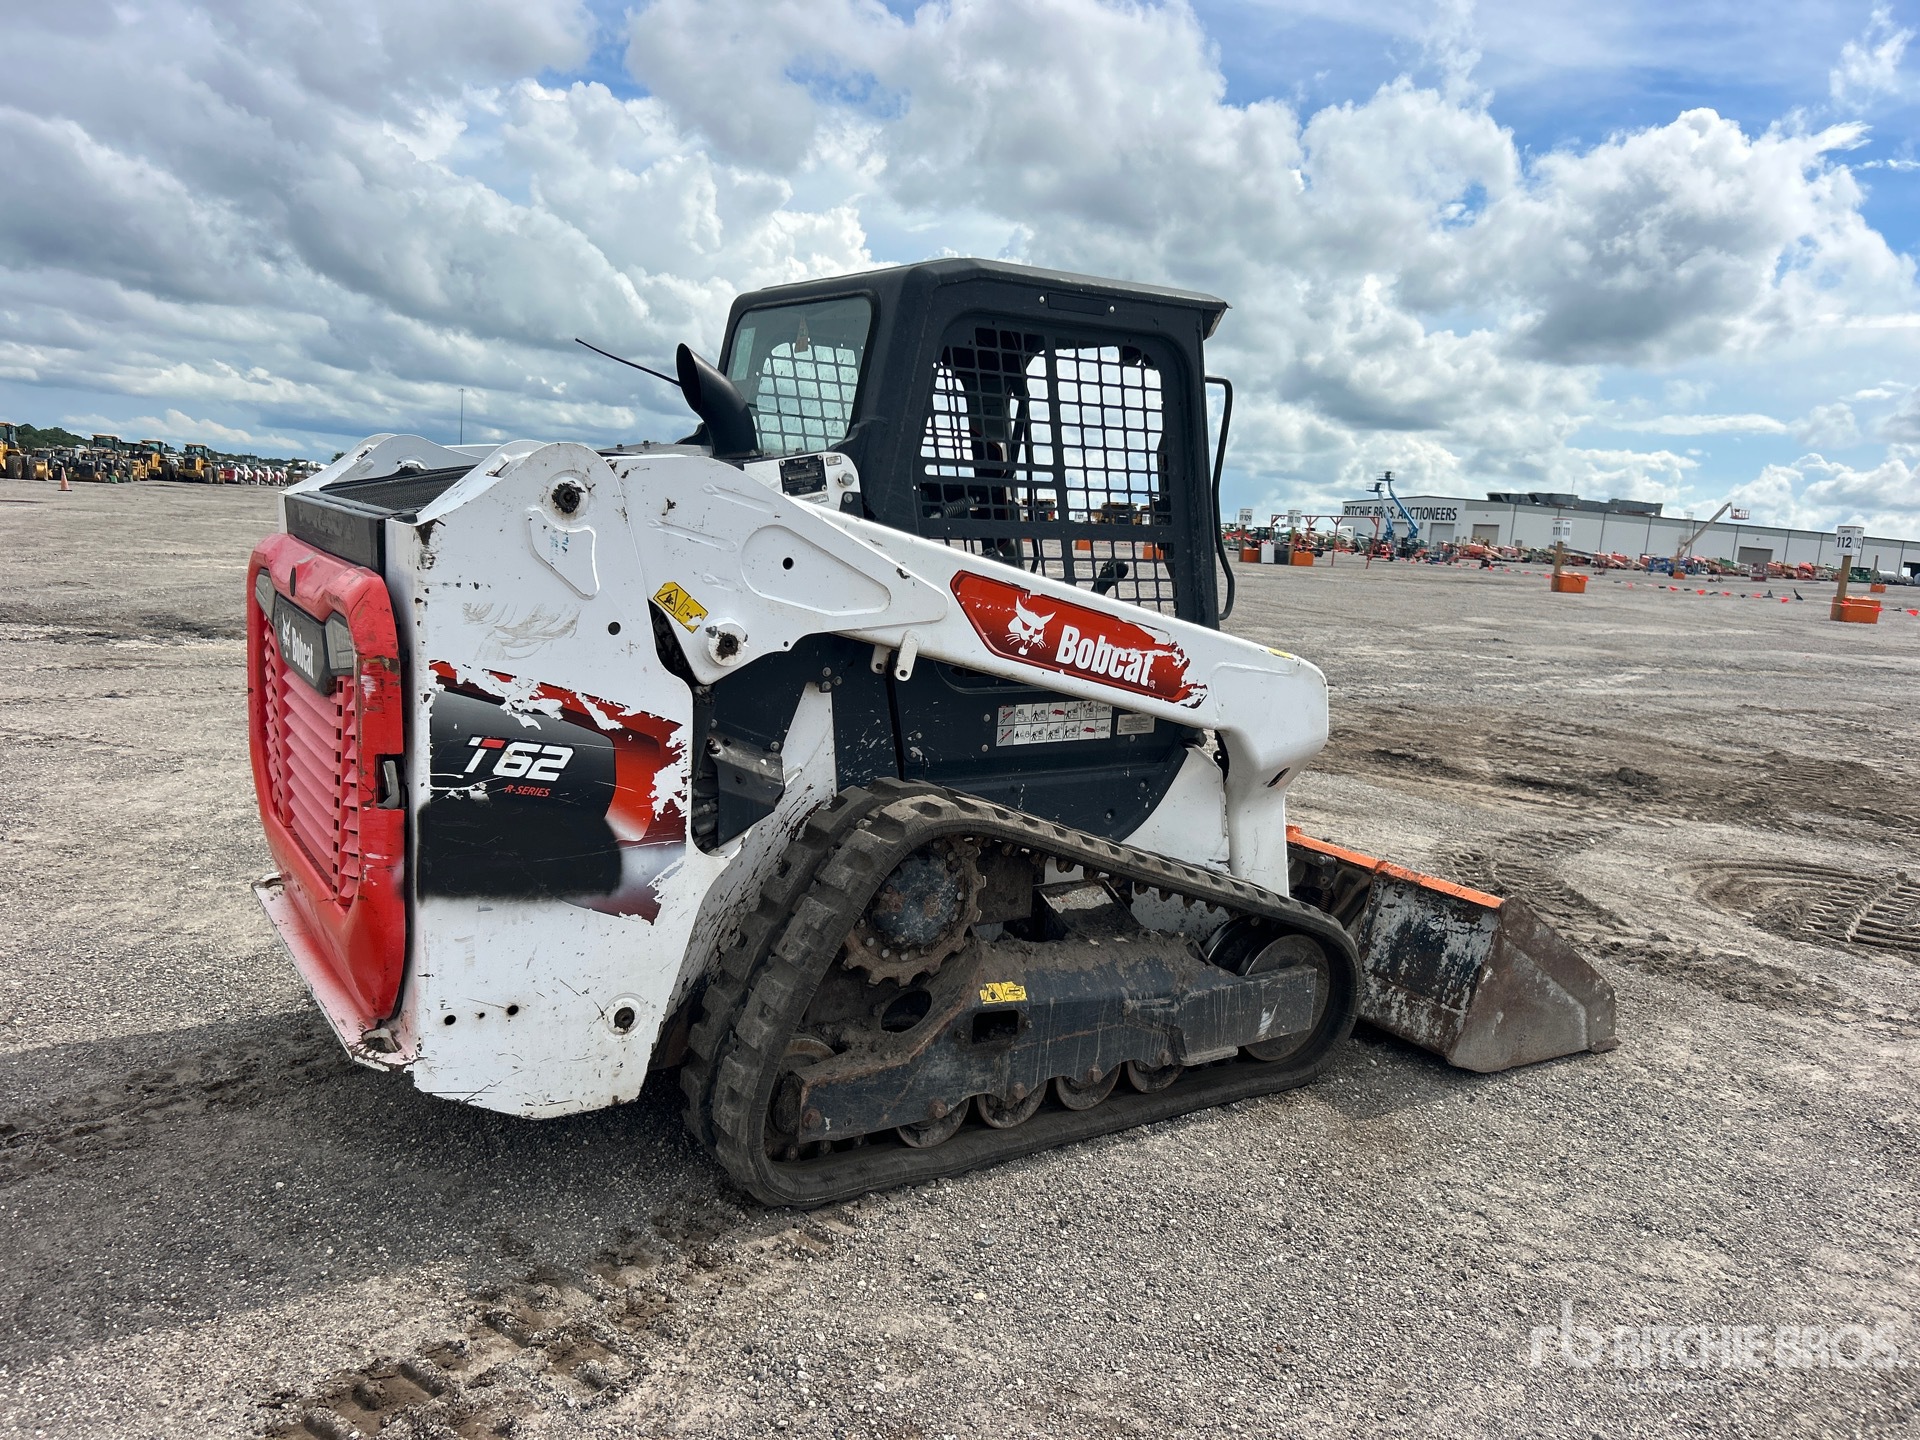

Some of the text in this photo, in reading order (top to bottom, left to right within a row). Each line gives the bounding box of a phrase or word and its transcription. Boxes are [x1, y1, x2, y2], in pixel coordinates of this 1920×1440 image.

[1344, 505, 1372, 516] RITCHIE
[1837, 537, 1852, 548] 112
[291, 626, 314, 679] Bobcat
[1055, 624, 1154, 686] Bobcat
[464, 736, 574, 782] T62
[504, 784, 551, 798] R-SERIES
